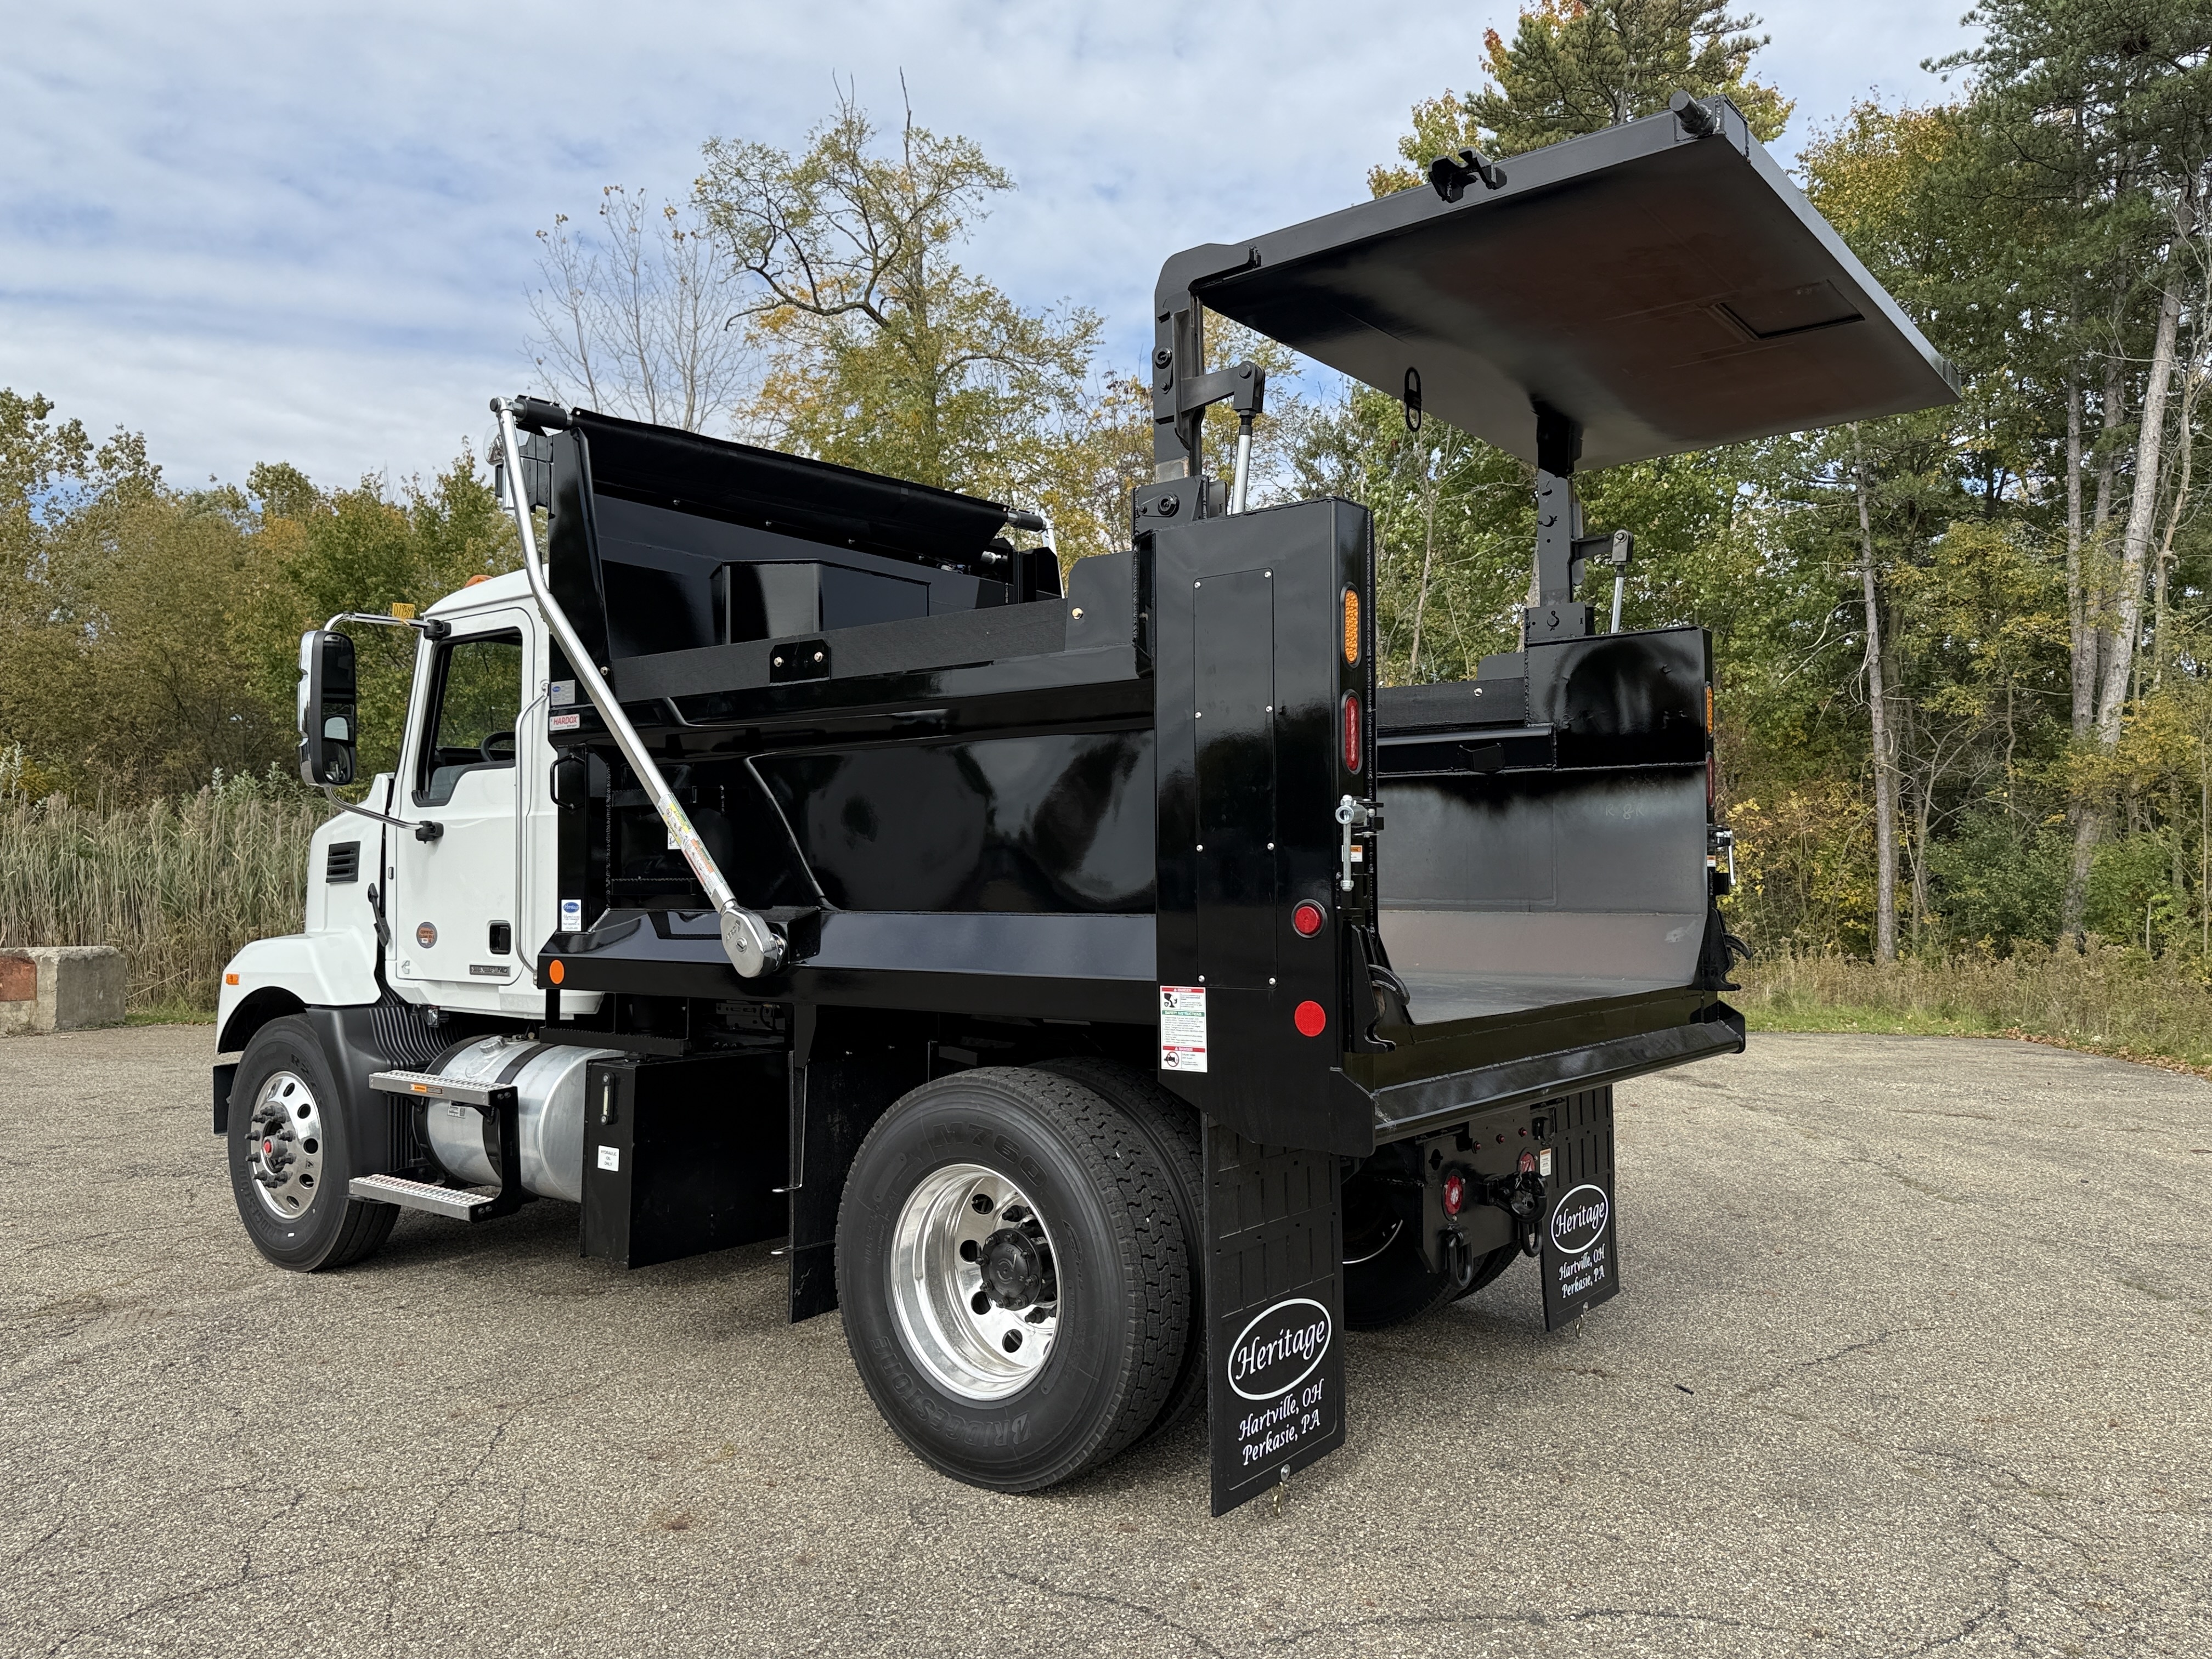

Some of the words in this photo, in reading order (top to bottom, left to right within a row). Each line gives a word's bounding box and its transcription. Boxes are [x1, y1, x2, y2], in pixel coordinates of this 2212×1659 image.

[554, 716, 577, 725] HARDOX
[933, 1121, 1048, 1187] M760
[1555, 1201, 1605, 1238] Heritage
[1559, 1251, 1593, 1280] Hartville,
[1593, 1243, 1605, 1263] OH
[1561, 1273, 1593, 1299] Perkasie,
[1593, 1265, 1605, 1282] PA
[1235, 1320, 1325, 1381] Heritage
[870, 1336, 1031, 1447] BRIDGESTONE
[1238, 1393, 1299, 1441] Hartville,
[1302, 1378, 1324, 1407] OH
[1243, 1424, 1298, 1466] Perkasie,
[1301, 1408, 1321, 1435] PA
